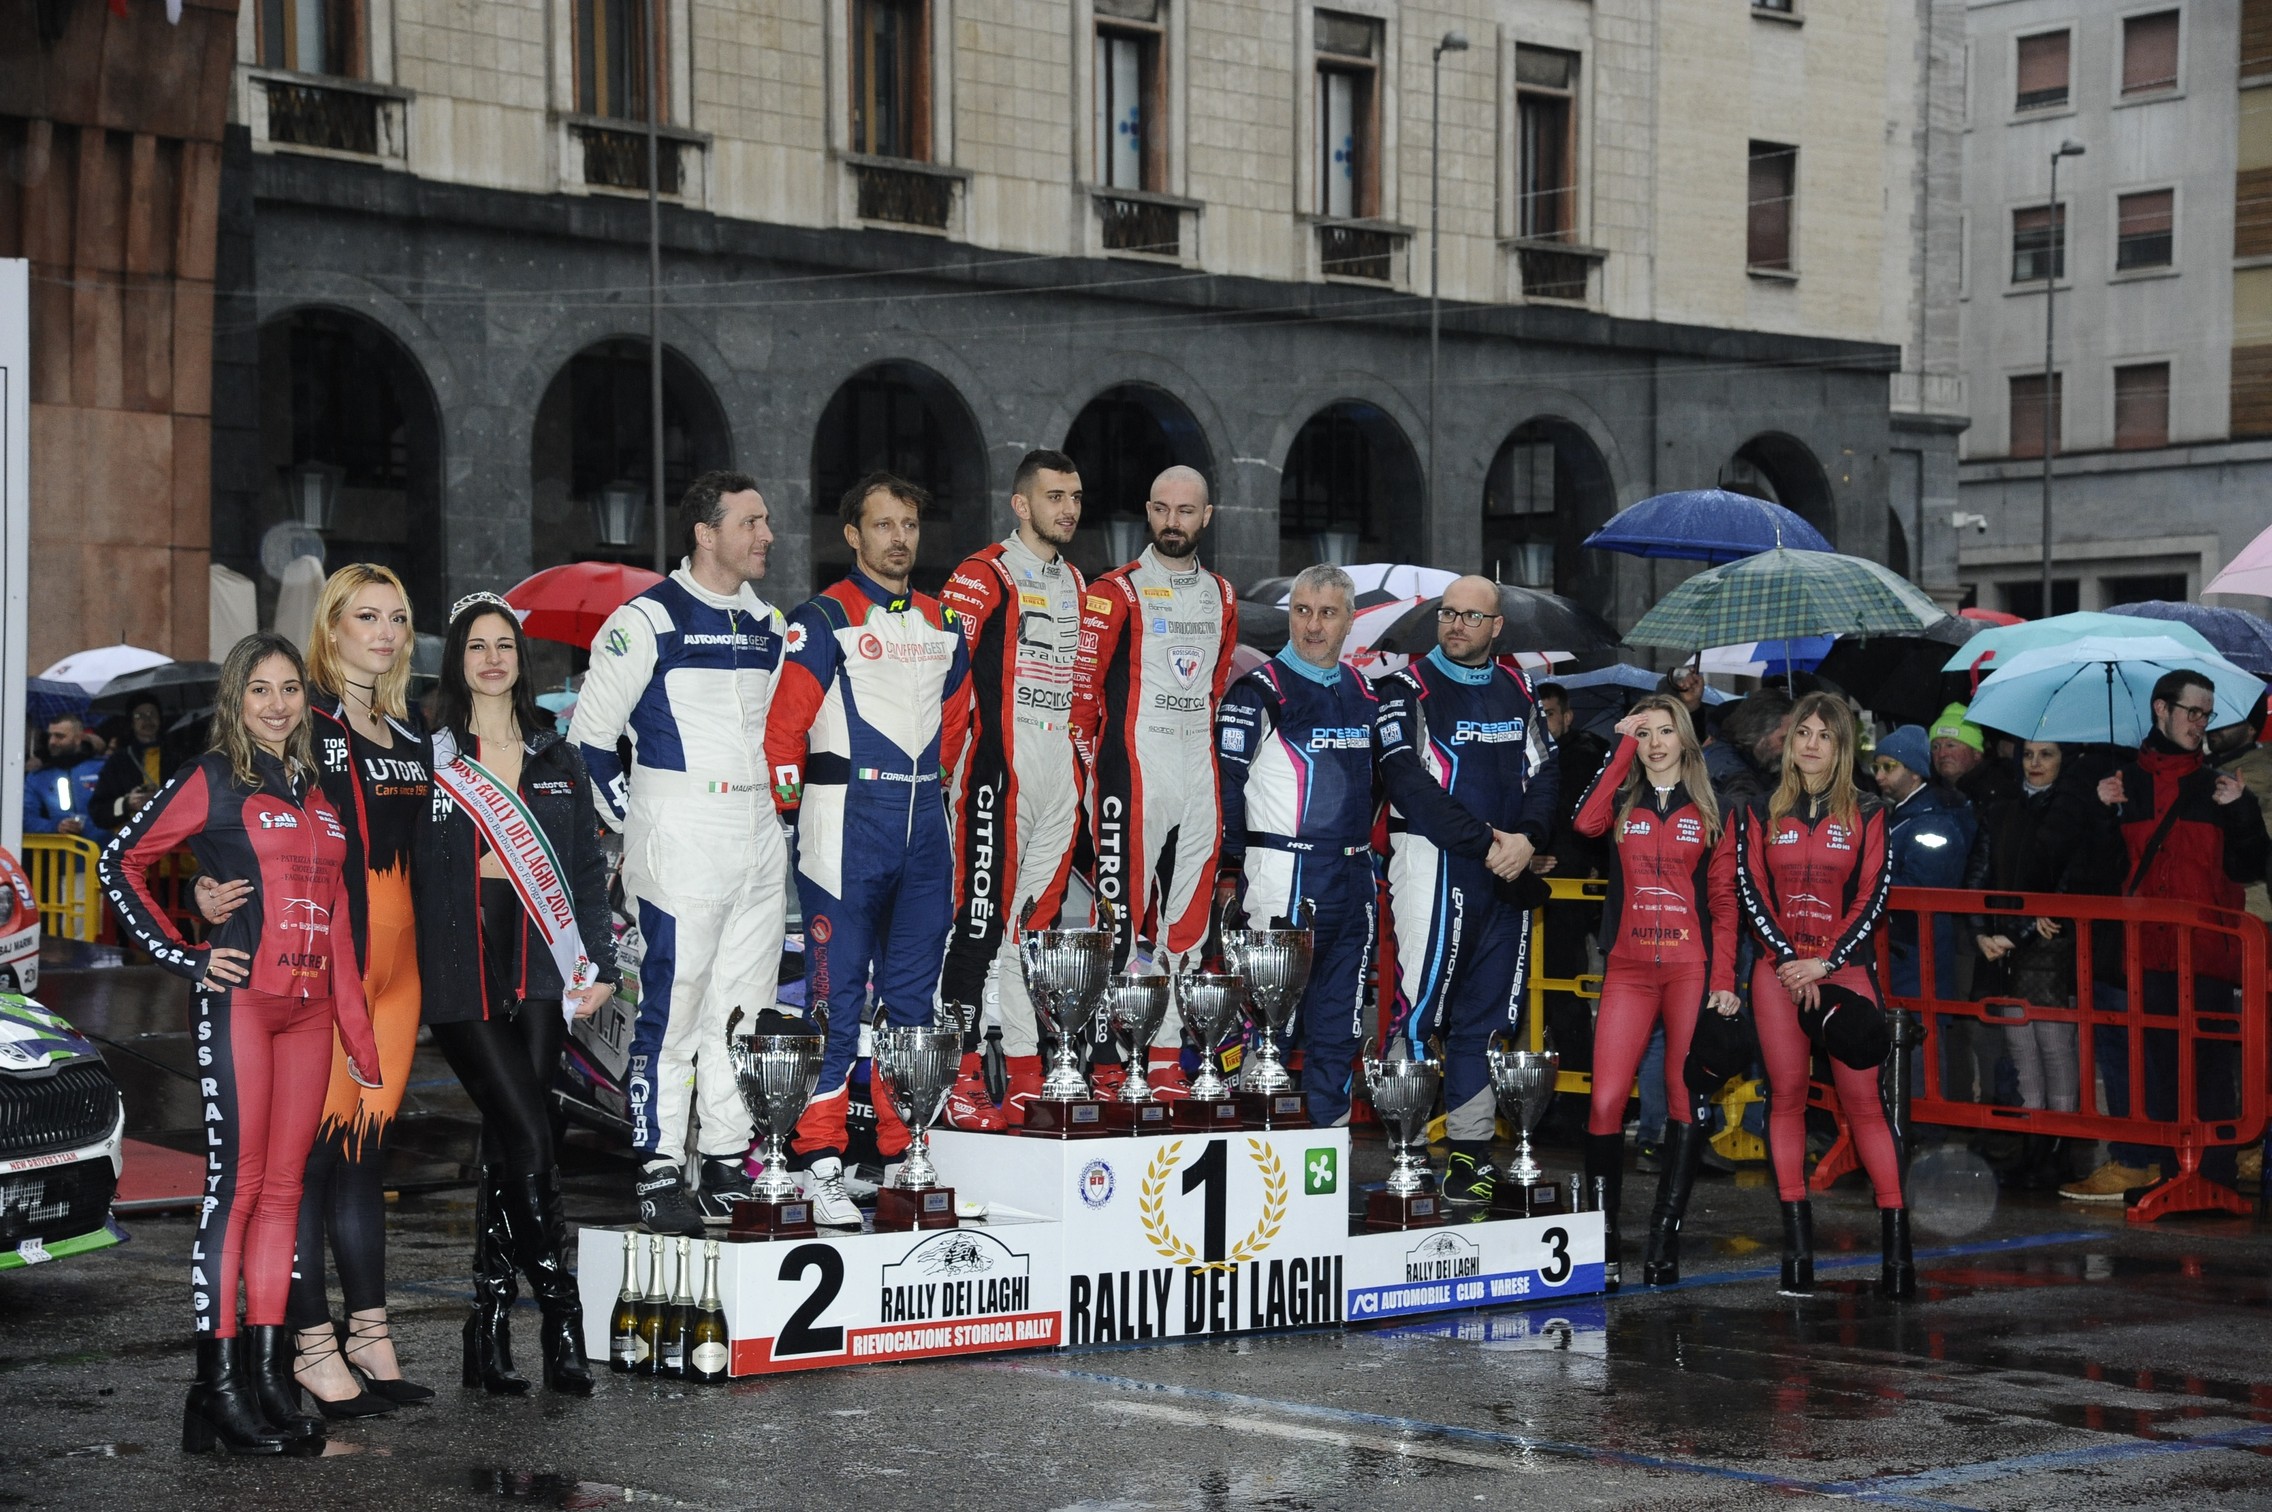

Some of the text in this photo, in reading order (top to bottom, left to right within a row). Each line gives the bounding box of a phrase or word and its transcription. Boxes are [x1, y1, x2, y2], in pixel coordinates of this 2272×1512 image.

[375, 784, 398, 797] Cars
[432, 799, 453, 814] PN
[455, 781, 548, 915] by Eugenio Barbaresco Fotografo
[475, 779, 518, 823] RALLY
[505, 821, 534, 851] DEI
[521, 846, 557, 892] LAGHI
[546, 889, 573, 931] 2024
[1287, 842, 1314, 851] HRX
[108, 889, 137, 926] DEI
[1632, 927, 1689, 941] AUTOREX
[200, 1077, 223, 1193] RALLY
[9, 1160, 27, 1171] NEW
[58, 1151, 79, 1163] TEAM
[1182, 1139, 1228, 1263] 1
[1406, 1256, 1480, 1283] RALLY DEI LAGHI
[1541, 1226, 1571, 1283] 3
[775, 1243, 845, 1357] 2
[881, 1276, 1029, 1323] RALLY DEI LAGHI
[1069, 1254, 1343, 1345] RALLY DEI LAGHI
[1381, 1285, 1450, 1311] AUTOMOBILE
[1456, 1281, 1485, 1301] CLUB
[1490, 1276, 1530, 1298] VARESE
[853, 1318, 1054, 1356] RIEVOCAZIONE STORICA RALLY
